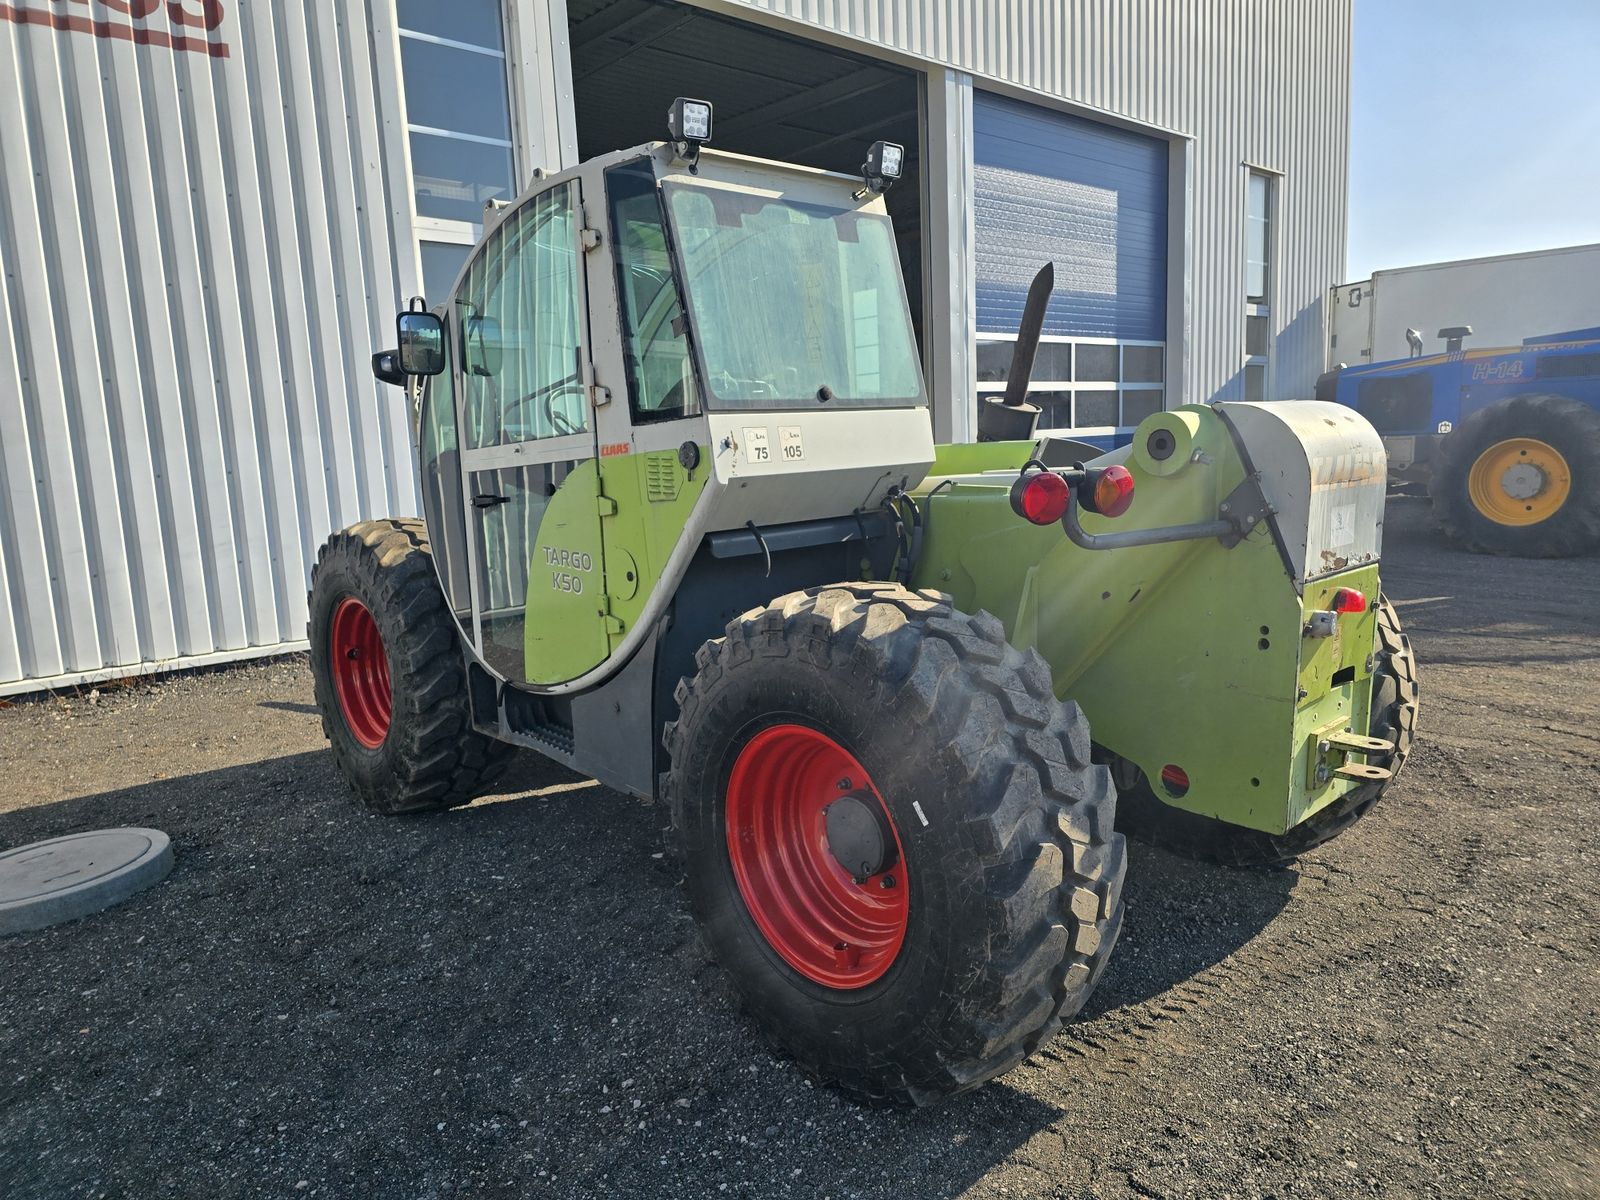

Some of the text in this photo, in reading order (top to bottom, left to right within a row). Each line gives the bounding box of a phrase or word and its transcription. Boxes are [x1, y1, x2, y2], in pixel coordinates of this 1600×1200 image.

[1472, 360, 1523, 380] H-14
[600, 442, 630, 457] CLAAS
[754, 446, 769, 460] 75
[783, 445, 802, 458] 105
[542, 546, 593, 572] TARGO
[552, 571, 582, 595] K50
